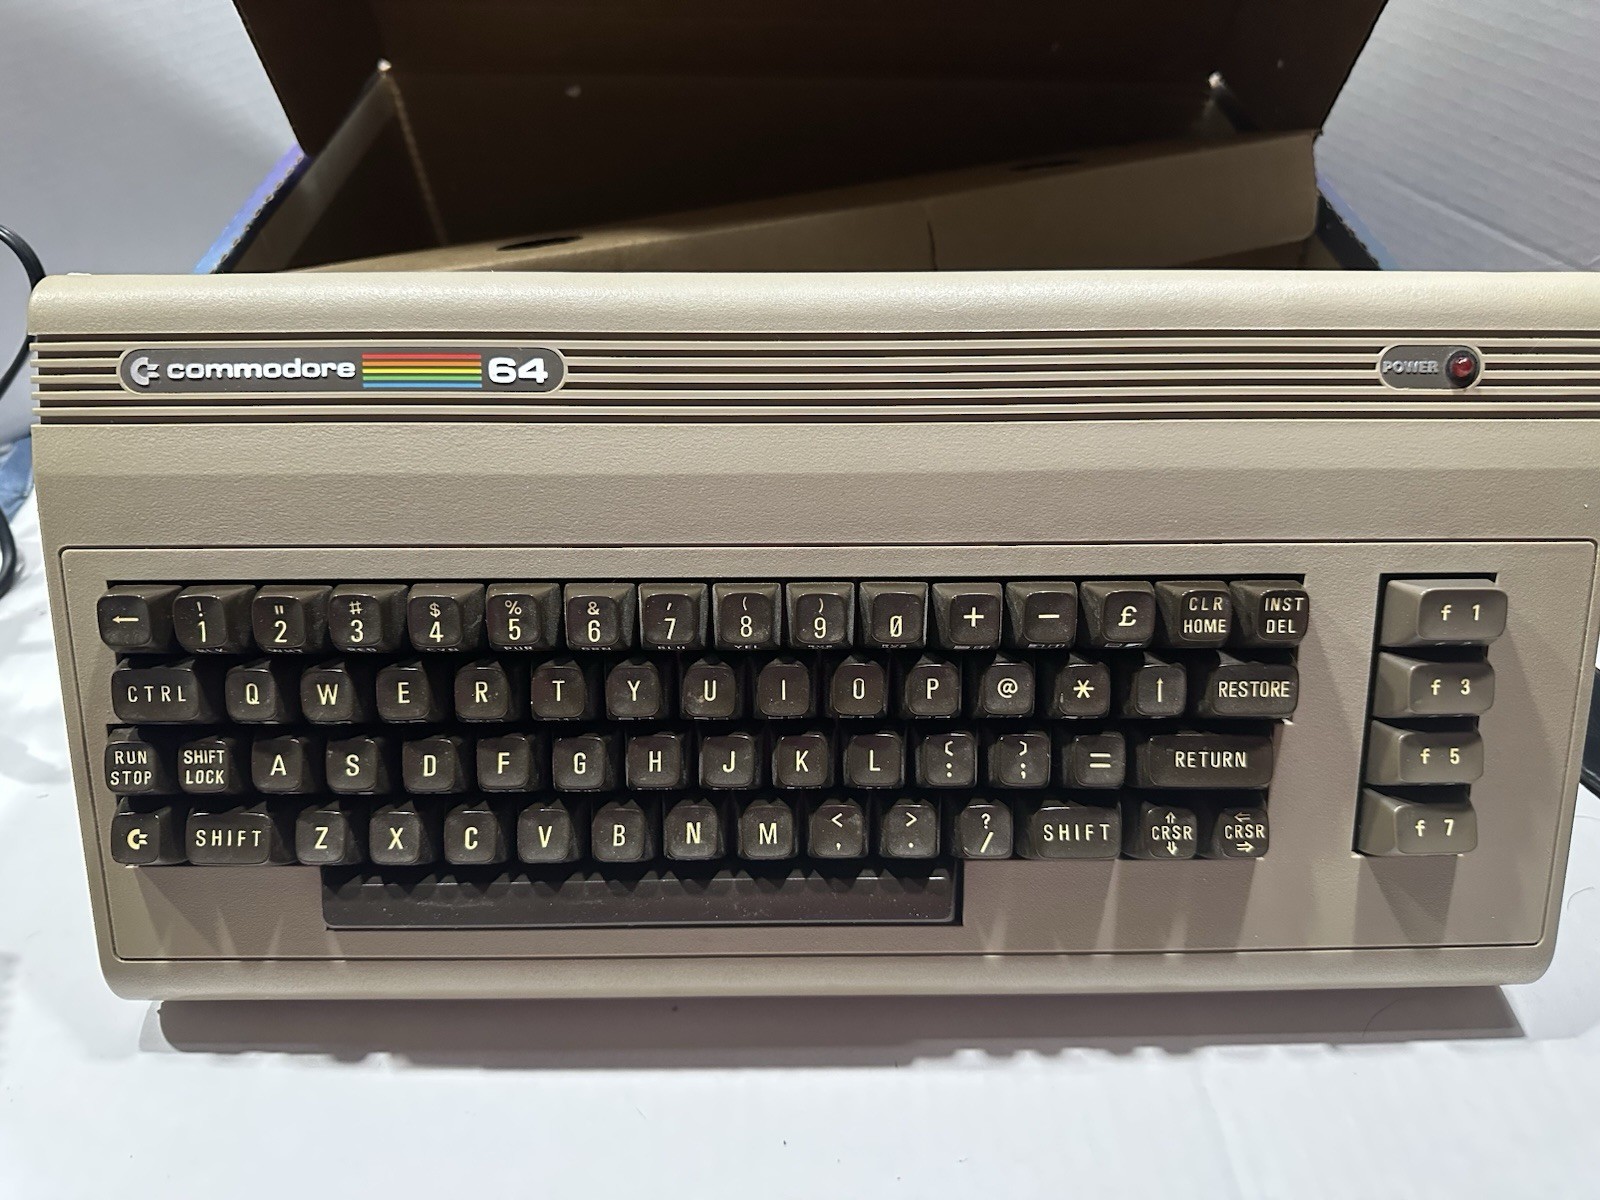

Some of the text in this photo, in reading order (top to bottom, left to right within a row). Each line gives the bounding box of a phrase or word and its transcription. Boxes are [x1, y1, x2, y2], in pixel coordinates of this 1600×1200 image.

[167, 357, 548, 383] commodore 64
[1382, 360, 1439, 374] POWER
[196, 601, 204, 618] !
[274, 605, 284, 615] "
[350, 601, 362, 614] #
[430, 603, 440, 617] $
[505, 601, 522, 614] %
[588, 602, 599, 615] &
[742, 596, 748, 611] (
[818, 597, 824, 614] )
[1190, 597, 1222, 610] CLR
[1265, 598, 1304, 611] INST
[1441, 604, 1480, 621] f 1
[964, 607, 984, 627] +
[1118, 606, 1137, 626] £
[1184, 619, 1226, 633] HOME
[198, 620, 207, 643] 1
[275, 621, 287, 642] 2
[351, 620, 363, 642] 3
[430, 622, 443, 642] 4
[509, 619, 520, 640] 5
[588, 620, 600, 642] 6
[665, 618, 675, 639] 7
[741, 616, 752, 637] 8
[815, 617, 826, 638] 9
[1267, 620, 1296, 633] DEL
[128, 686, 186, 702] CTRL
[246, 684, 259, 704] Q
[317, 684, 338, 705] W
[398, 682, 410, 703] E
[476, 682, 487, 703] R
[553, 681, 564, 701] T
[628, 681, 640, 701] Y
[703, 680, 717, 703] U
[854, 678, 864, 699] O
[927, 679, 939, 699] P
[998, 679, 1018, 698] @
[1219, 681, 1289, 697] RESTORE
[1431, 679, 1470, 695] f 3
[115, 751, 147, 764] RUN
[184, 750, 224, 764] SHIFT
[271, 755, 286, 775] A
[346, 755, 359, 776] S
[424, 755, 436, 776] D
[498, 753, 509, 774] F
[574, 753, 586, 774] G
[649, 751, 661, 772] H
[723, 751, 735, 772] J
[796, 751, 808, 772] K
[870, 750, 880, 771] L
[1090, 753, 1111, 768] =
[1176, 752, 1246, 767] RETURN
[1421, 748, 1459, 764] f 5
[111, 771, 151, 785] STOP
[186, 770, 224, 784] LOCK
[945, 762, 953, 778] :
[1020, 762, 1027, 780] ;
[832, 813, 842, 827] <
[906, 813, 917, 826] >
[982, 813, 992, 830] ?
[1415, 819, 1453, 836] f 7
[196, 830, 261, 846] SHIFT
[315, 827, 328, 849] Z
[389, 828, 403, 849] X
[465, 827, 477, 849] C
[539, 826, 552, 847] V
[613, 825, 625, 846] B
[687, 822, 700, 844] N
[760, 823, 777, 844] M
[1044, 824, 1109, 841] SHIFT
[1151, 826, 1193, 841] CRSR
[1224, 824, 1266, 839] CRSR
[980, 831, 994, 853] /
